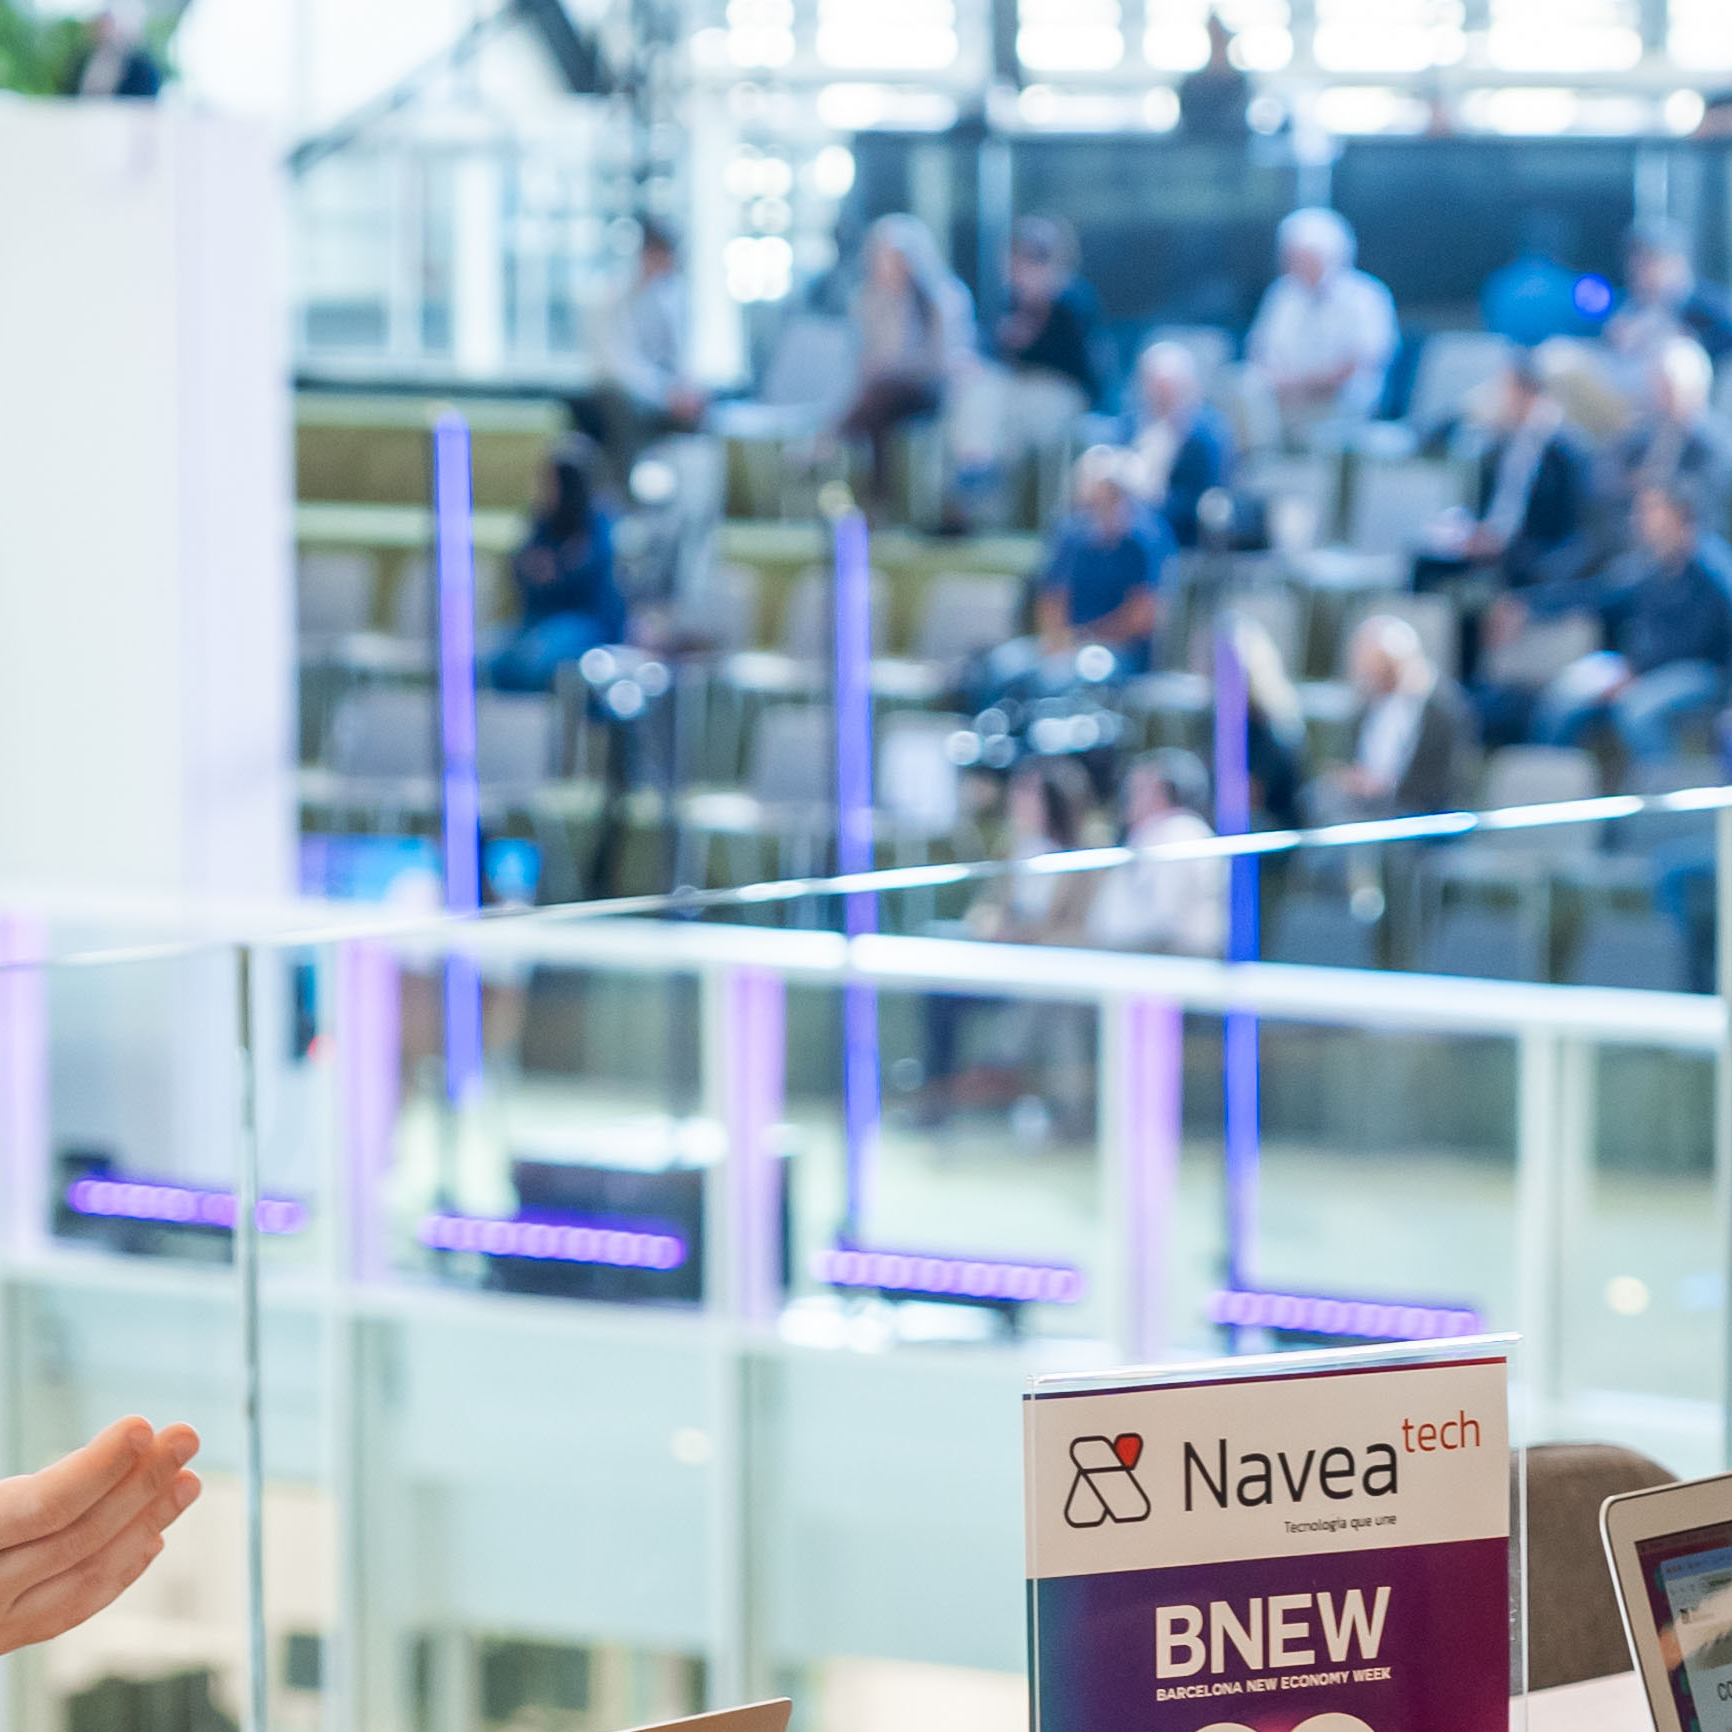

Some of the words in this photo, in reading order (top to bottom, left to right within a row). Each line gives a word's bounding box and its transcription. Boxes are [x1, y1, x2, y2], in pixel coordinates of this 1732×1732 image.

[1182, 1438, 1400, 1512] Navea
[1401, 1409, 1482, 1454] tech
[1350, 1516, 1373, 1531] que
[1375, 1514, 1397, 1527] une
[1154, 1585, 1392, 1680] BNEW
[1155, 1681, 1244, 1702] BARCELONA
[1245, 1676, 1279, 1692] NEW
[1280, 1669, 1351, 1690] ECONOMY
[1352, 1665, 1392, 1683] WEEK
